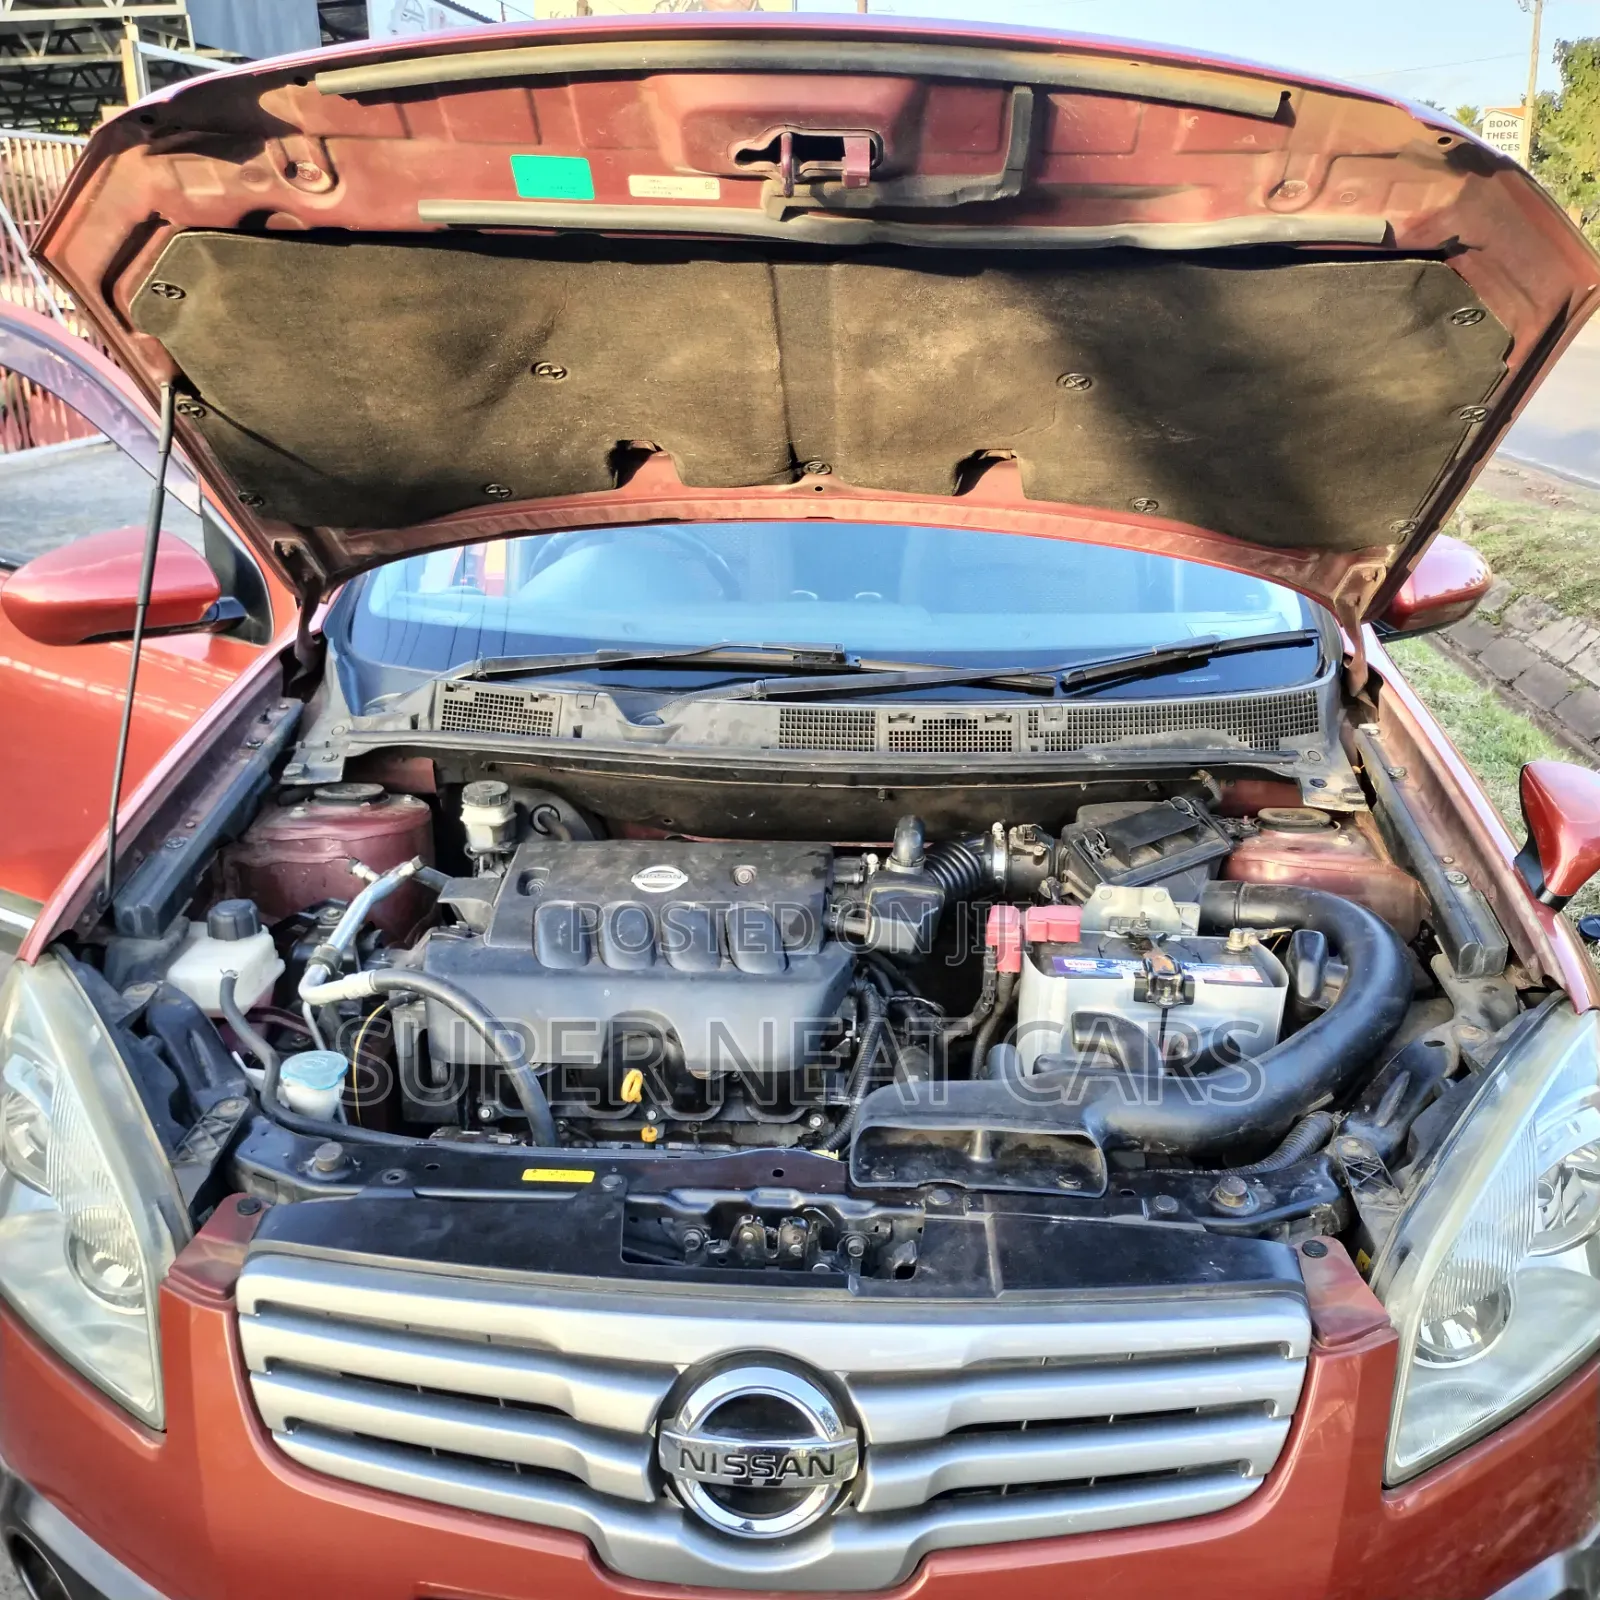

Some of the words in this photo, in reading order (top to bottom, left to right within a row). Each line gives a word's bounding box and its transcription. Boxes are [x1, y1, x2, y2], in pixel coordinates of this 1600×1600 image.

[1489, 120, 1518, 128] BOOK
[1485, 132, 1519, 140] THESE
[1491, 143, 1520, 152] ACES
[678, 1446, 836, 1481] NISSAN
